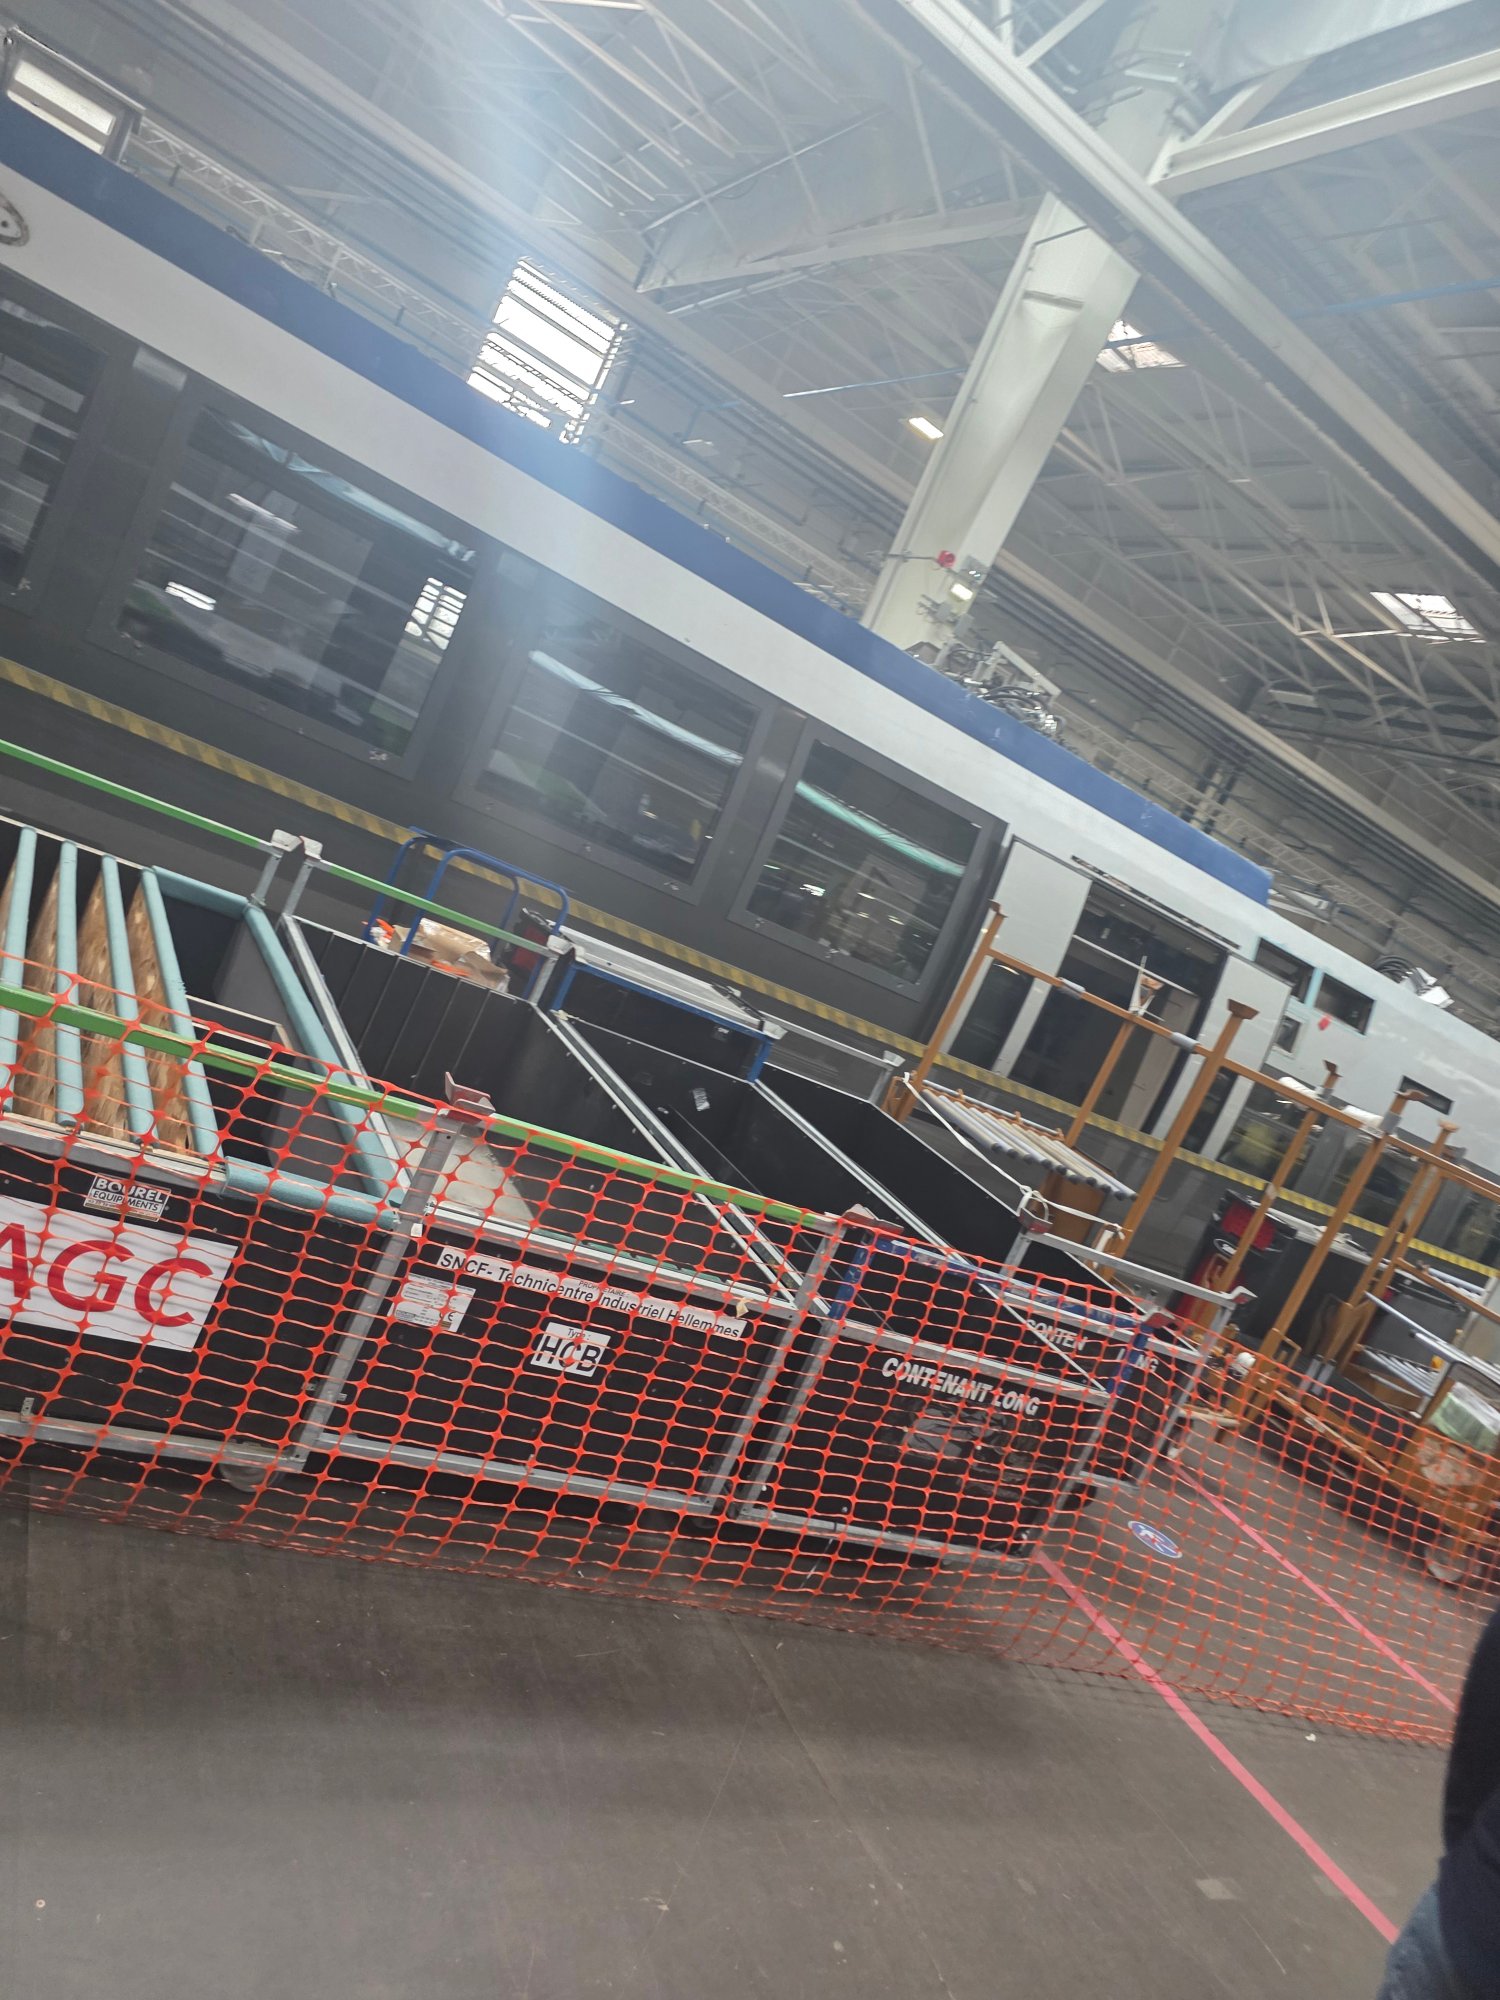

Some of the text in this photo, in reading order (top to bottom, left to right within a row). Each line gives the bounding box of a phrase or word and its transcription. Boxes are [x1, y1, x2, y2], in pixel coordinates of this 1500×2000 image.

[93, 1190, 159, 1211] EQUIPMENTS
[96, 1178, 163, 1203] BOUREL
[0, 1222, 213, 1328] AGC
[498, 1266, 594, 1302] Technicentre
[665, 1308, 740, 1338] Hellemmes
[535, 1335, 601, 1372] HCB
[881, 1357, 1041, 1416] CONTENANT LONG
